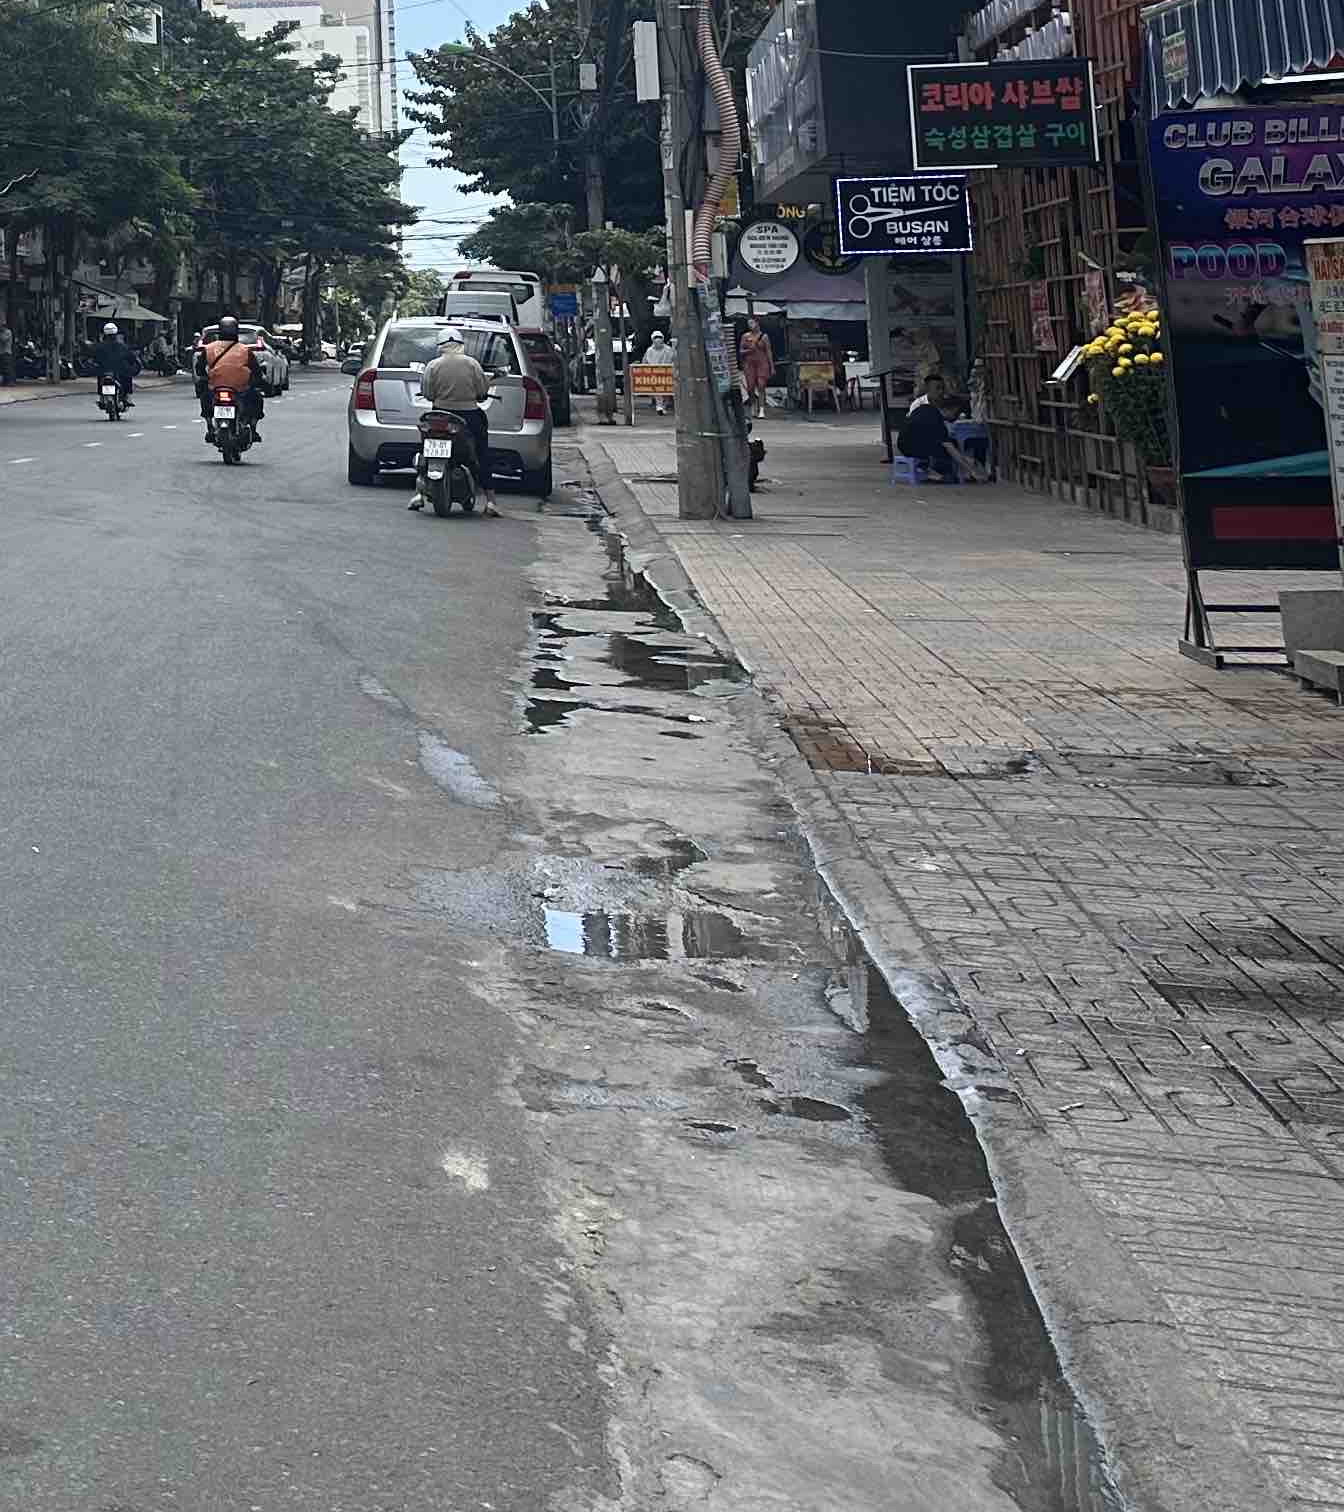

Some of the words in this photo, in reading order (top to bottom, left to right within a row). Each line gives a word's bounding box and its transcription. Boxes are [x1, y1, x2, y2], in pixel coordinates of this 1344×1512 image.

[921, 81, 993, 113] 코리아
[1044, 120, 1086, 147] 구이
[1164, 120, 1256, 150] CLUB
[1264, 116, 1344, 145] BILL
[870, 182, 916, 207] TIỆM
[920, 181, 960, 202] TÓC
[755, 225, 779, 234] SPA
[886, 220, 949, 235] BUSAN
